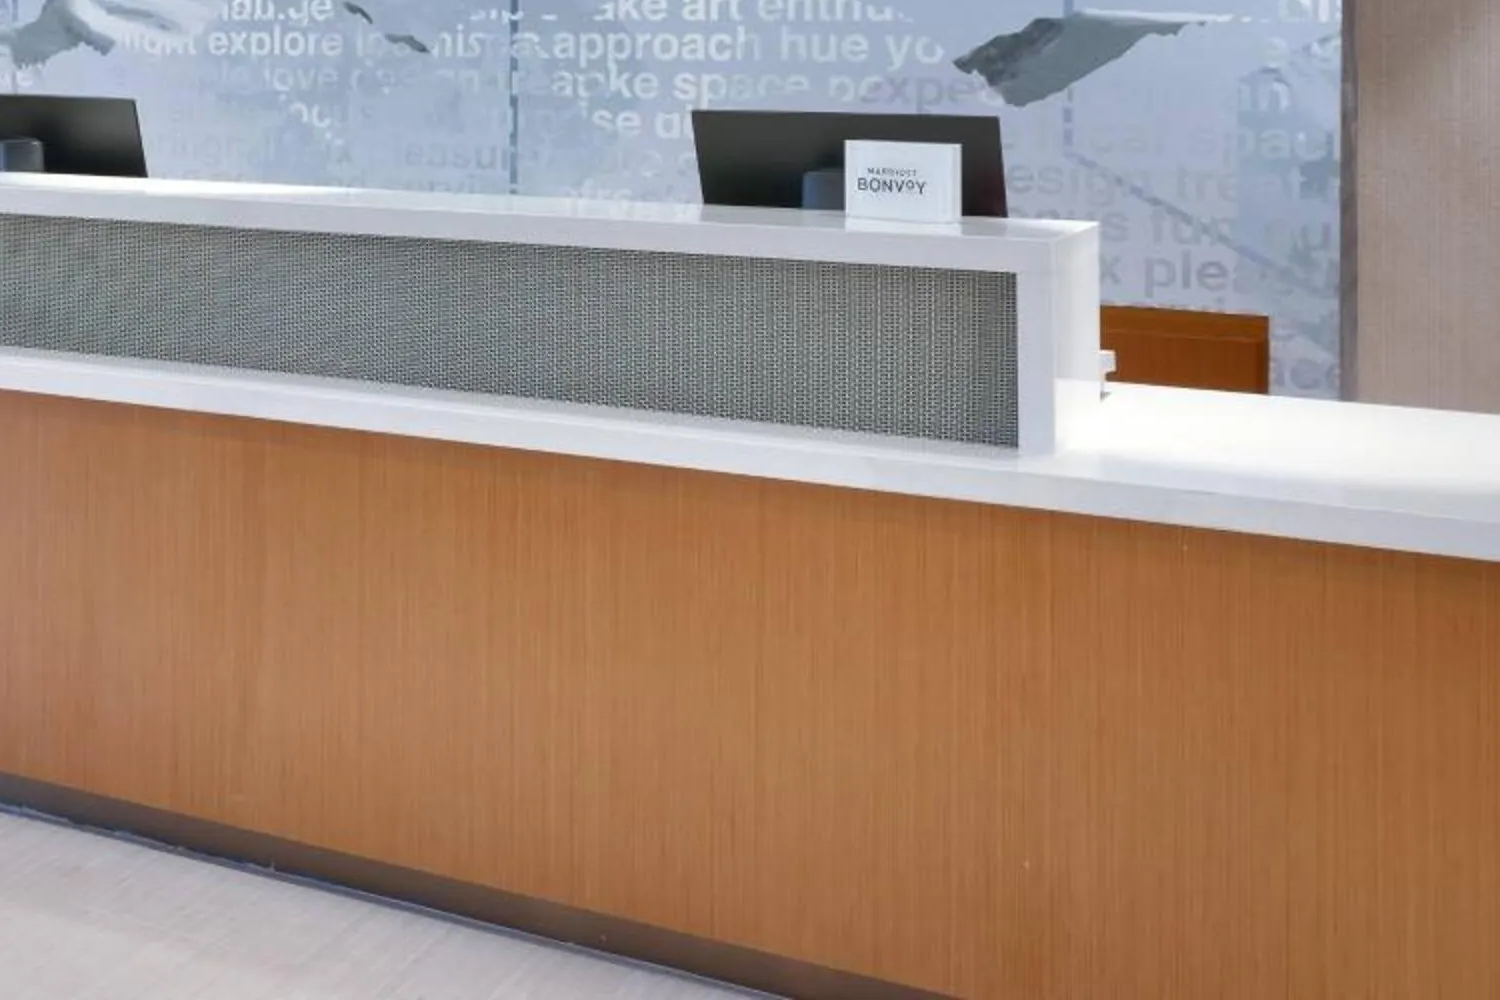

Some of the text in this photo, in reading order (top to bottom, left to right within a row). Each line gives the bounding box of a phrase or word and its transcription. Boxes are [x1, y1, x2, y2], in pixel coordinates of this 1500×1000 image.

[207, 24, 344, 63] explore
[552, 25, 764, 68] approach
[780, 25, 870, 63] hue
